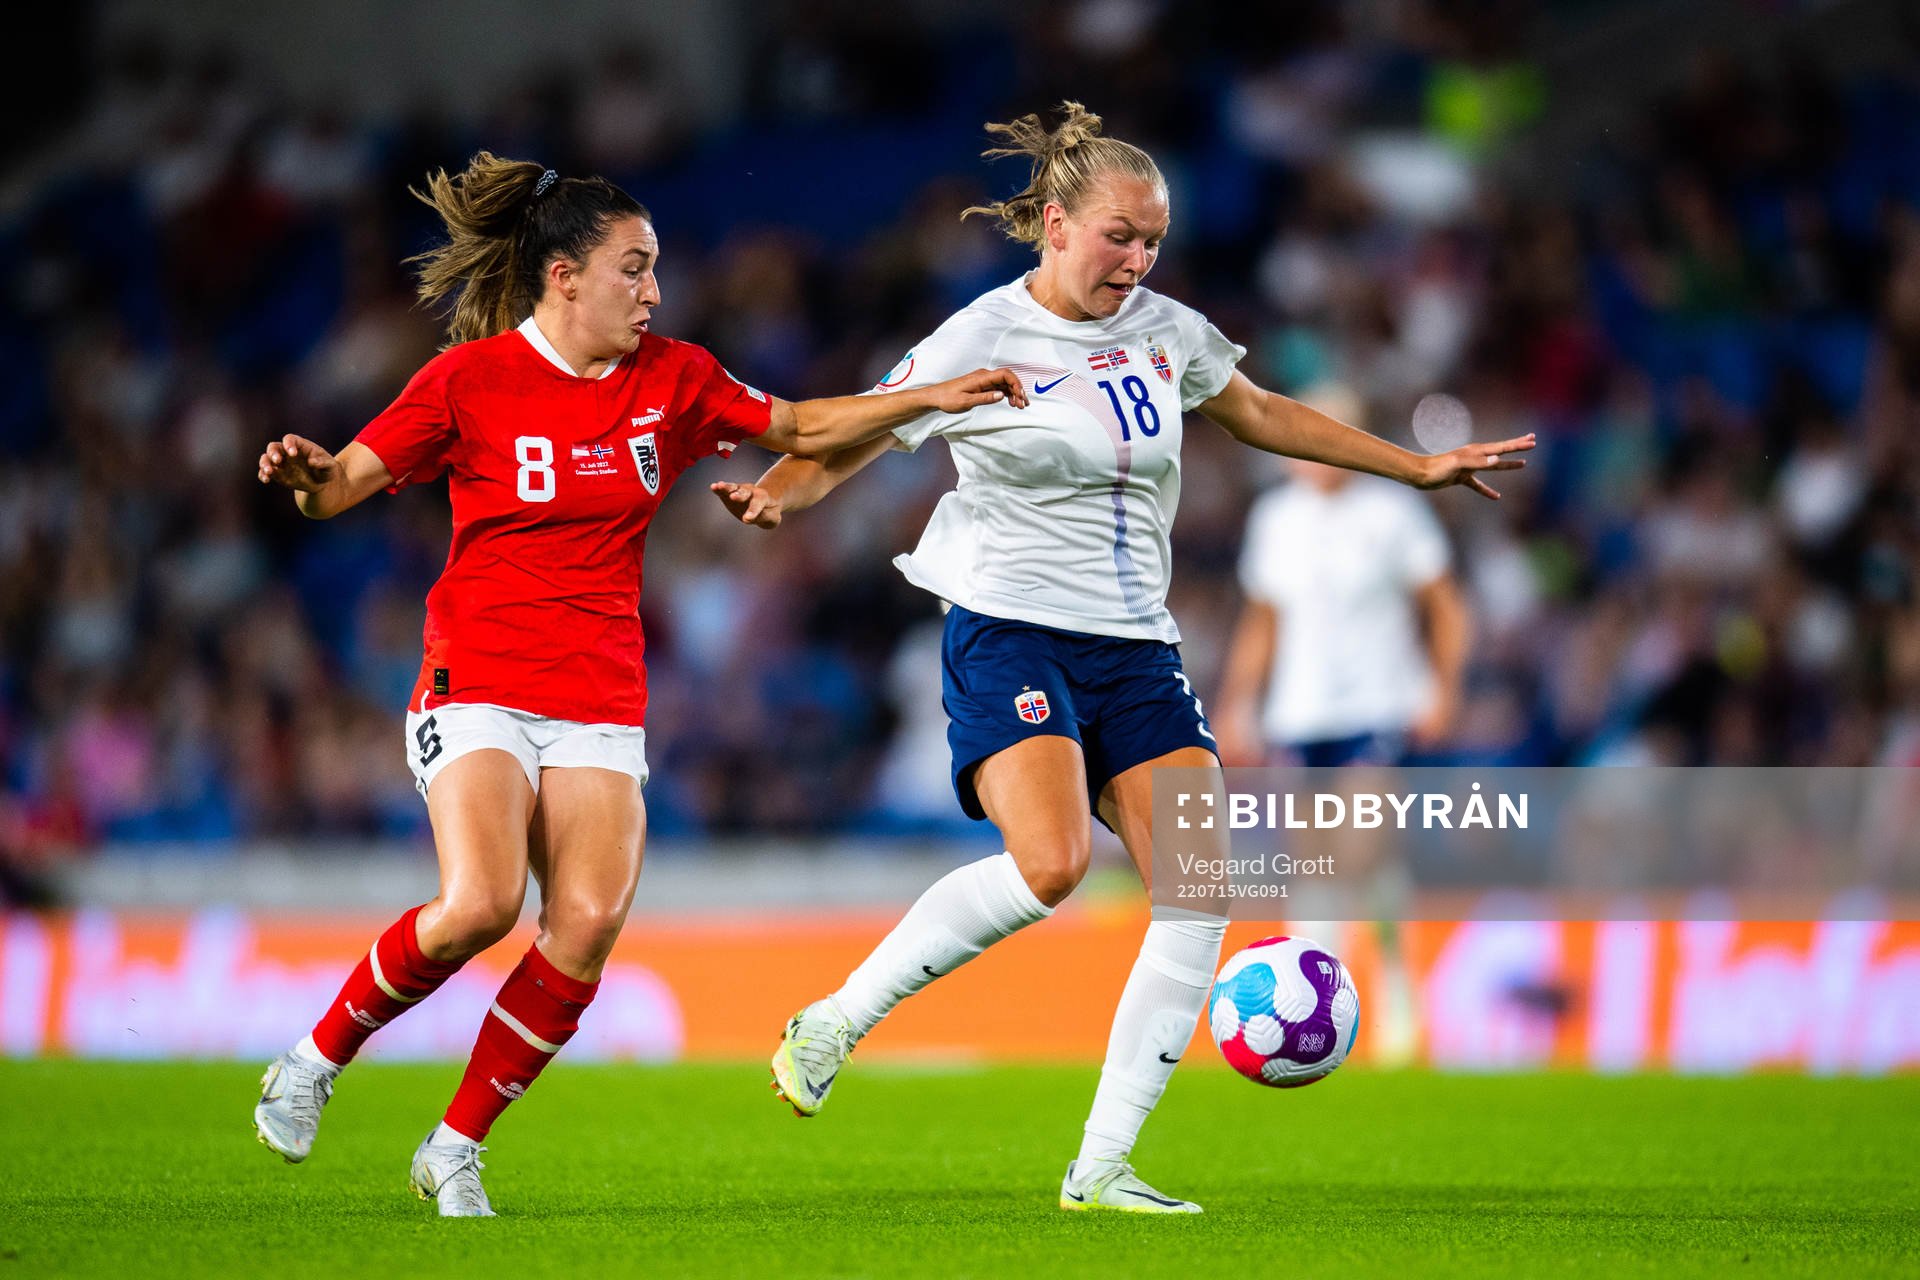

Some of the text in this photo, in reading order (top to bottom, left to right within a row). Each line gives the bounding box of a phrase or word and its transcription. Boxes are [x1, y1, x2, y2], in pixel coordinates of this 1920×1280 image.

[631, 413, 661, 428] PUMA
[1098, 374, 1161, 442] 18
[514, 435, 556, 503] 8
